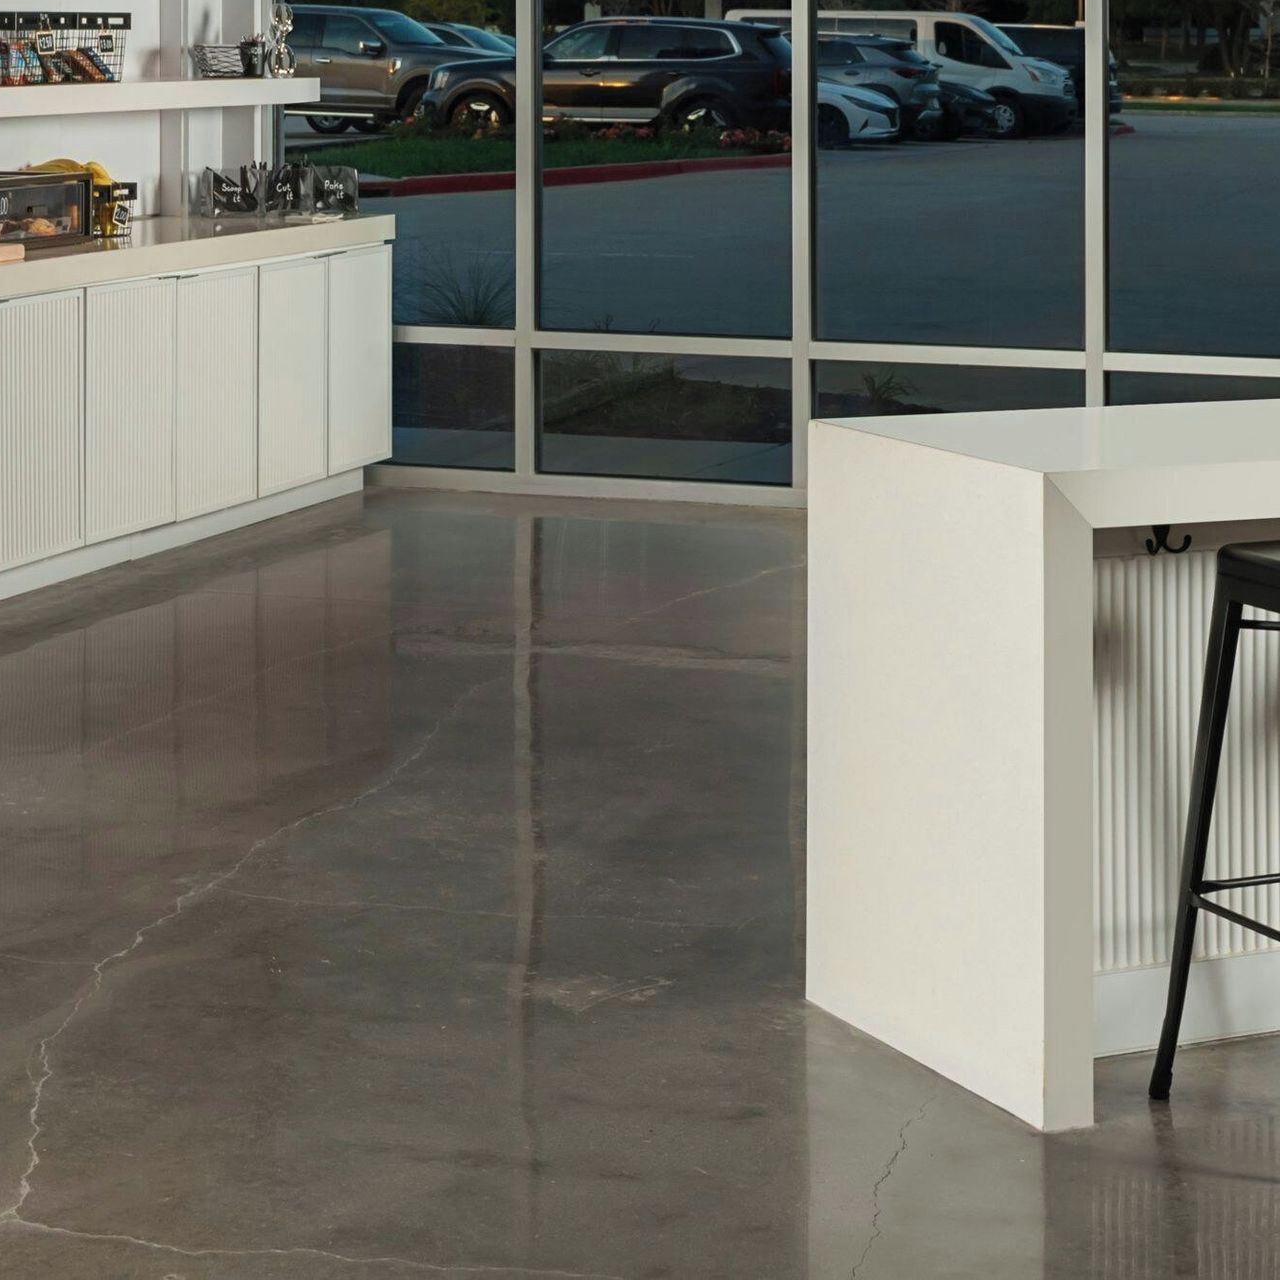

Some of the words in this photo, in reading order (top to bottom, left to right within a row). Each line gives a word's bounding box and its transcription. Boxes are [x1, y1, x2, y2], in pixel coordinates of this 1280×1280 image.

[222, 183, 242, 194] Scoop
[276, 183, 291, 192] Cut
[324, 180, 344, 190] Poke
[233, 194, 241, 203] it
[286, 191, 294, 200] it
[336, 190, 344, 199] it
